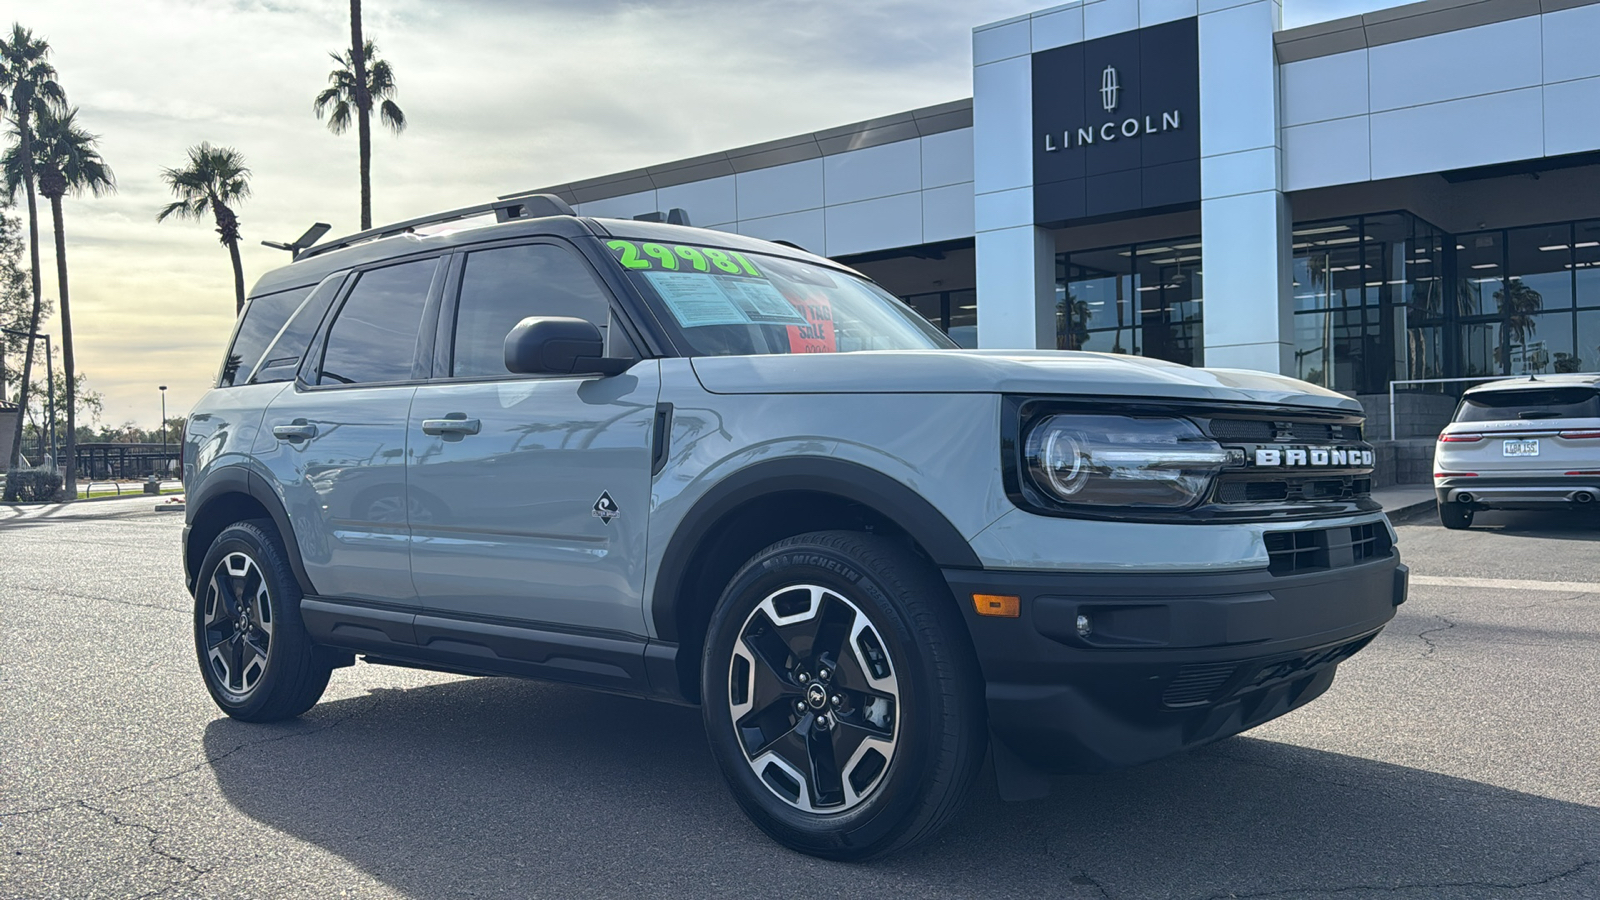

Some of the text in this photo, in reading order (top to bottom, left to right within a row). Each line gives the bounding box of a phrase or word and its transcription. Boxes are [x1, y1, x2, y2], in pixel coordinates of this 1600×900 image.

[1045, 110, 1181, 152] LINCOLN
[606, 240, 762, 277] 29981
[807, 304, 831, 321] TAG
[798, 323, 826, 340] SALE
[1255, 448, 1373, 467] BRONCO
[792, 555, 859, 582] MICHELIN
